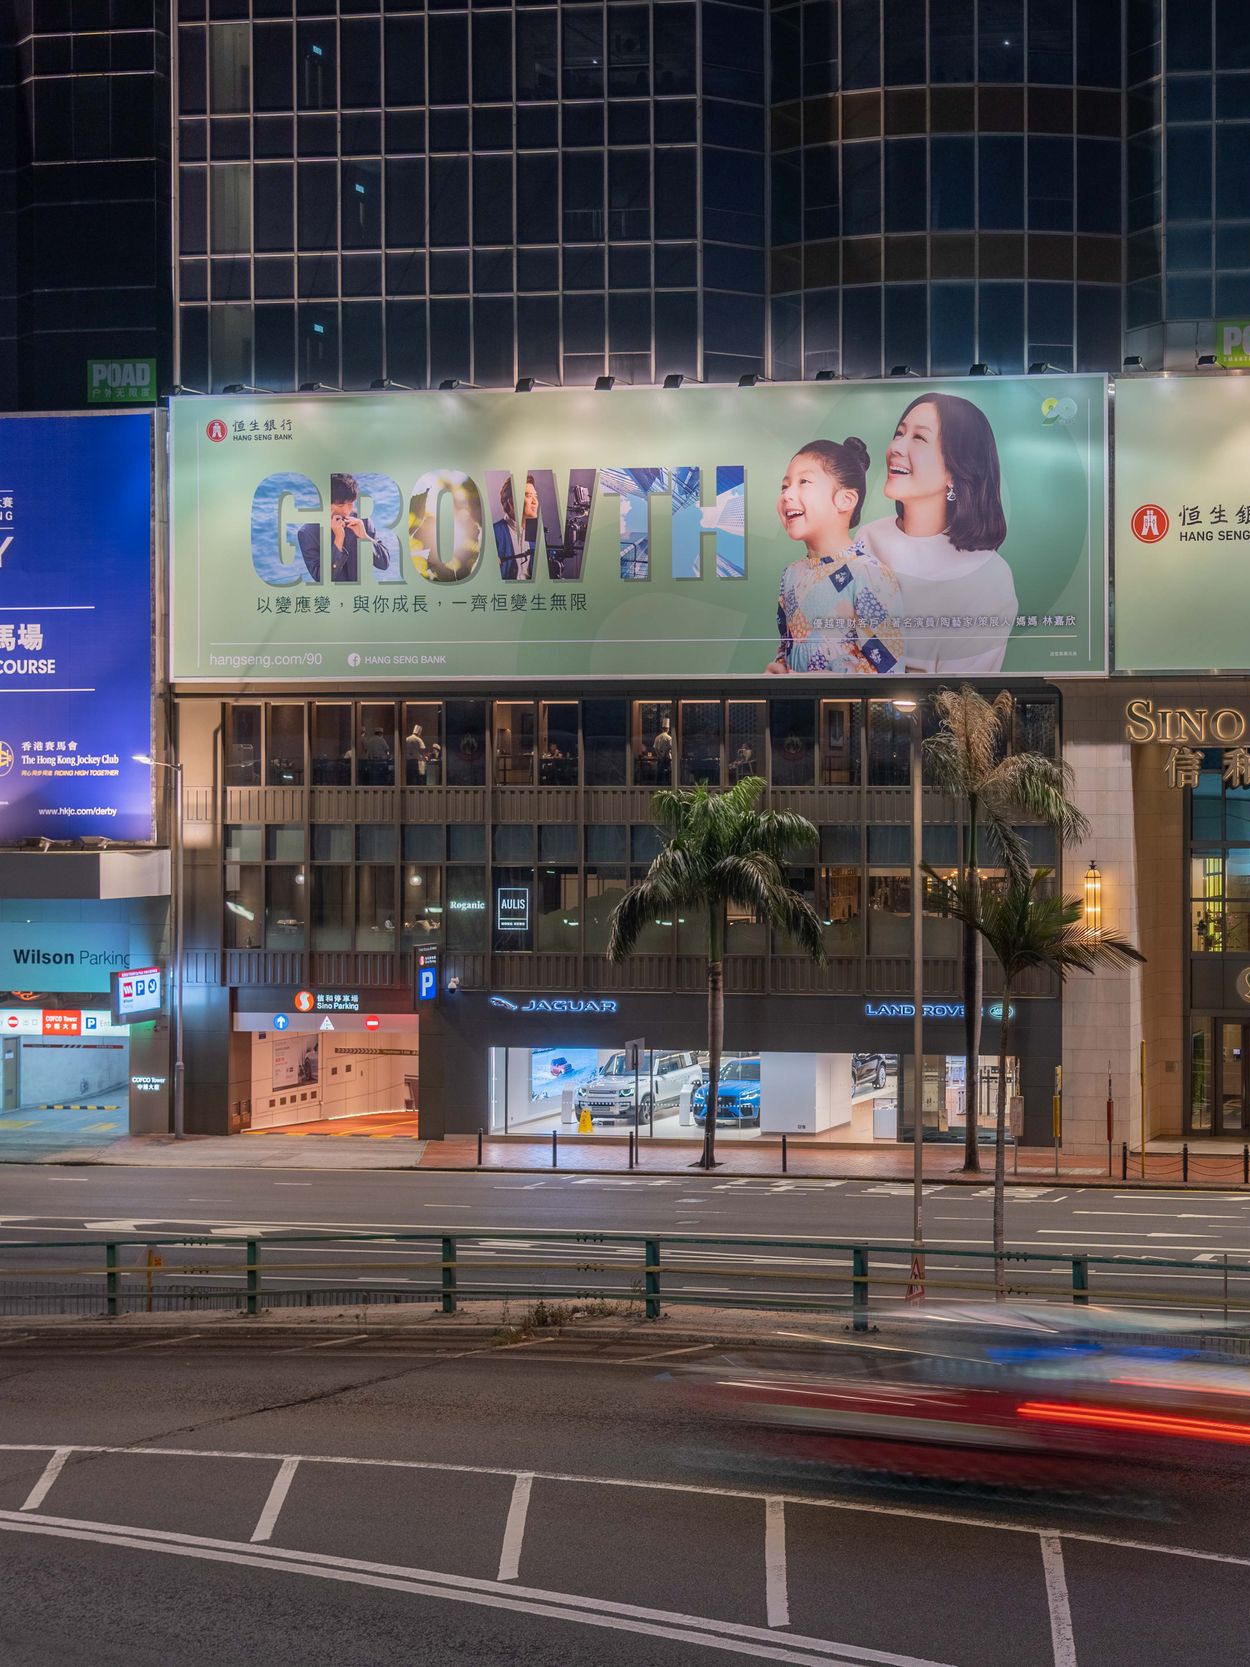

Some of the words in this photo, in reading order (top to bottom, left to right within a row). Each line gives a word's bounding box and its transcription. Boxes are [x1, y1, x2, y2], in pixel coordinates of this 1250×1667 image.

[92, 363, 150, 387] POAD
[232, 419, 293, 432] 恒生銀行
[250, 465, 747, 586] GROWTH
[1180, 531, 1213, 541] HANG
[1218, 530, 1250, 541] SENG
[210, 652, 322, 667] hangseng.com/90
[365, 655, 390, 664] HANG
[393, 655, 418, 664] SENG
[420, 655, 446, 664] BANK
[21, 741, 78, 752] 香港賽馬會
[21, 755, 36, 764] The
[37, 755, 56, 766] Hong
[57, 755, 75, 766] Kong
[75, 755, 100, 766] Jockey
[101, 754, 119, 764] Club
[39, 807, 118, 816] www.hkjc.com/derby
[450, 901, 485, 911] Roganic
[501, 899, 526, 909] AULIS
[13, 949, 75, 964] Wilson
[80, 950, 130, 969] Parking
[333, 1003, 359, 1011] Parking
[521, 1000, 617, 1013] JAGUAR
[865, 1004, 916, 1016] LAND
